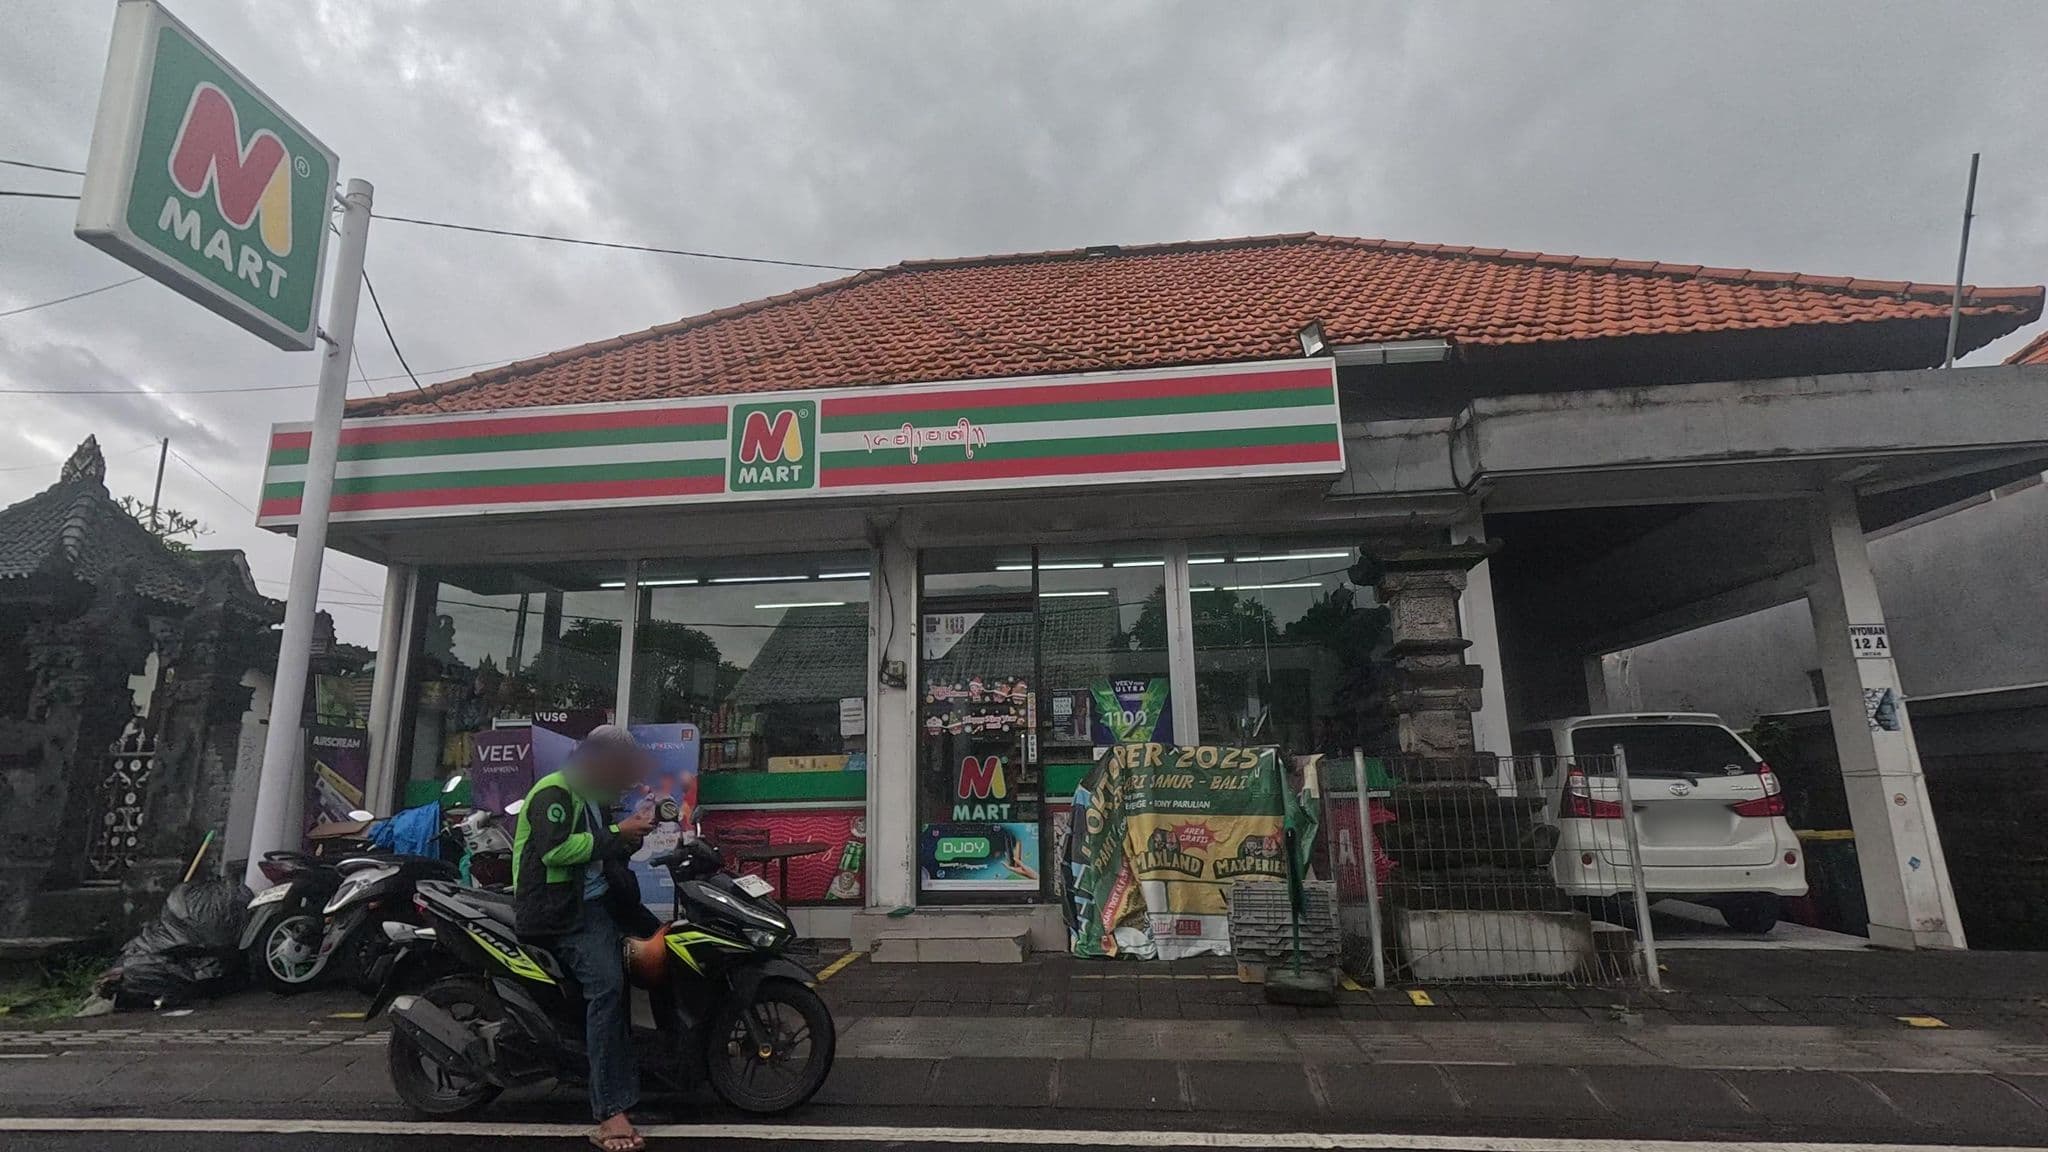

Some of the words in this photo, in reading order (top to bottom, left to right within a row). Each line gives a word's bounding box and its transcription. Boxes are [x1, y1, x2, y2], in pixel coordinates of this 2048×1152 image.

[157, 197, 288, 299] MART
[737, 465, 803, 484] MART
[1854, 637, 1872, 649] 12
[1876, 636, 1888, 649] A
[312, 735, 361, 749] AIRSCREAM
[477, 743, 531, 761] VEEV
[1175, 745, 1260, 769] 2025
[1210, 775, 1248, 790] BALI
[952, 803, 1011, 821] MART
[1180, 834, 1209, 844] GRATIS
[1184, 827, 1205, 836] AREA
